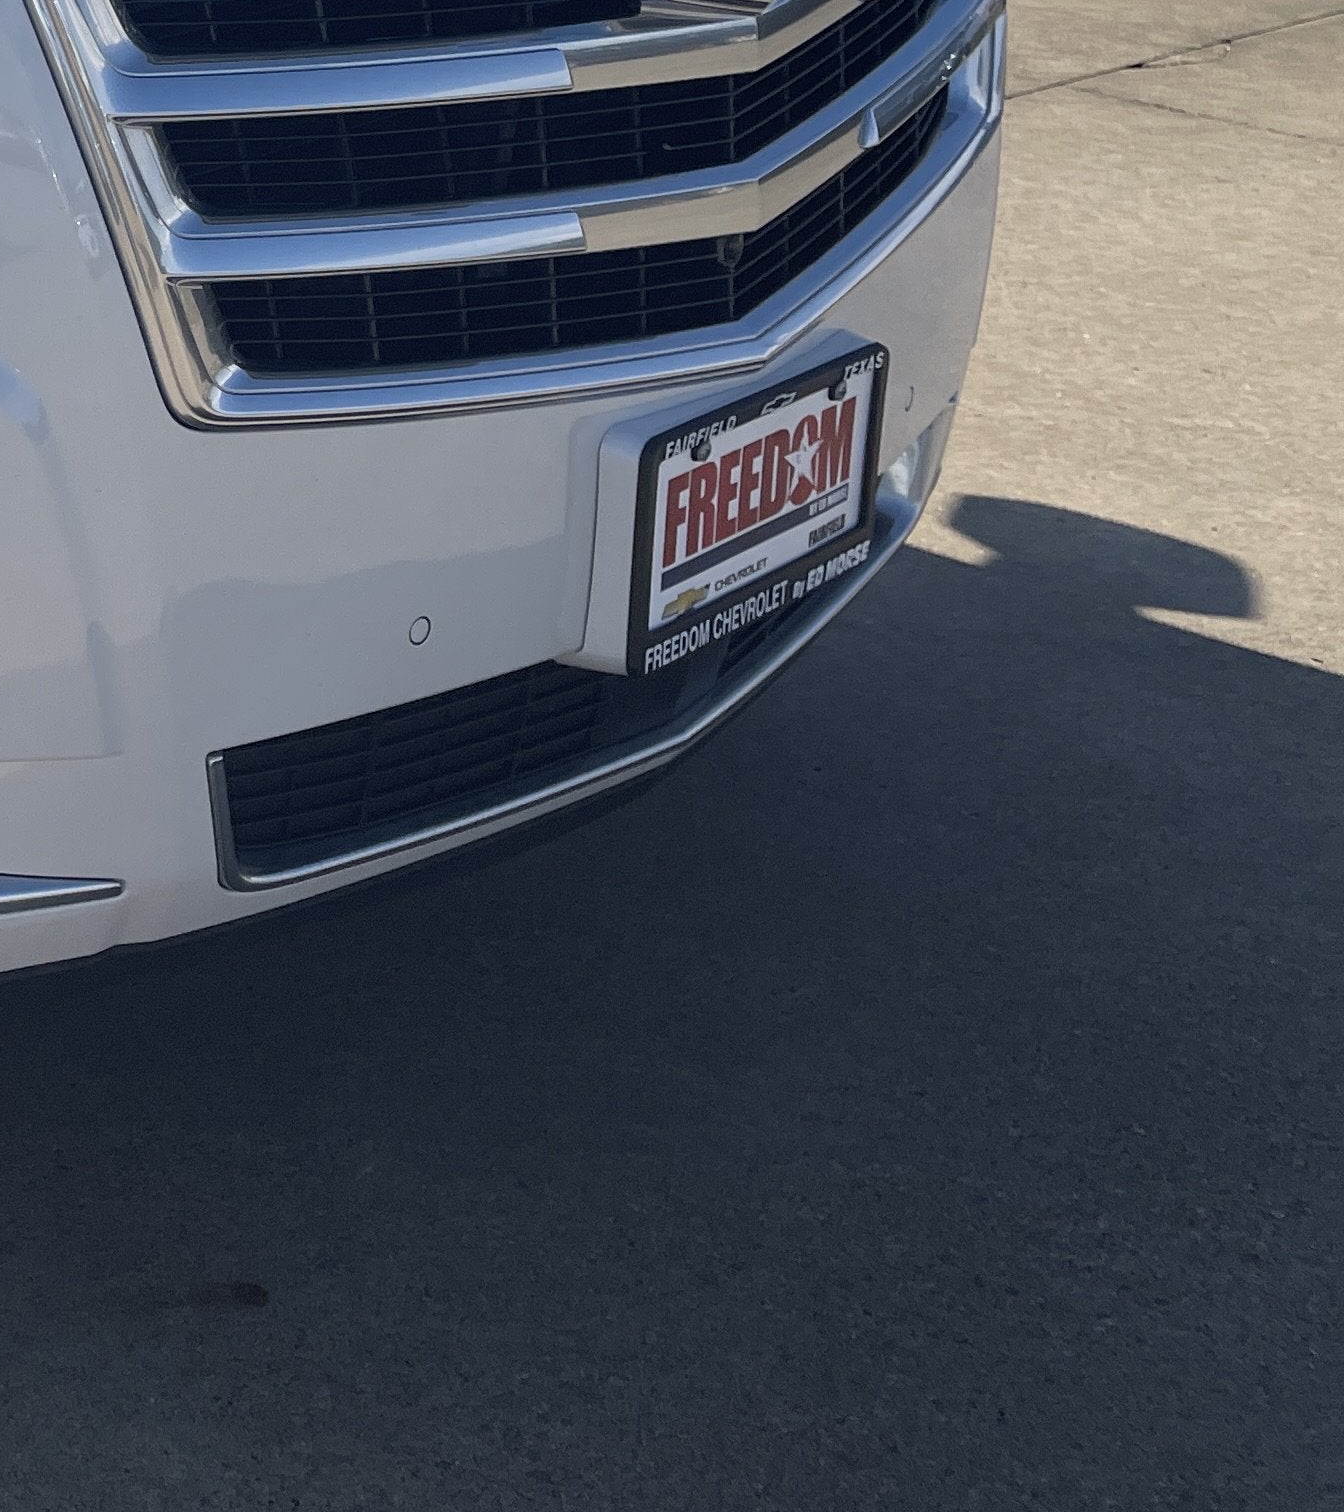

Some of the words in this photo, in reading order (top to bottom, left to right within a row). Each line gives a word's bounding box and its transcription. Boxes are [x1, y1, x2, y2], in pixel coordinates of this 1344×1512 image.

[665, 415, 737, 461] FAIRFIELD
[844, 352, 885, 381] TEXAS
[662, 395, 857, 569] FREEDOM
[644, 619, 711, 675] FREEDOM
[713, 579, 789, 640] CHEVROLET
